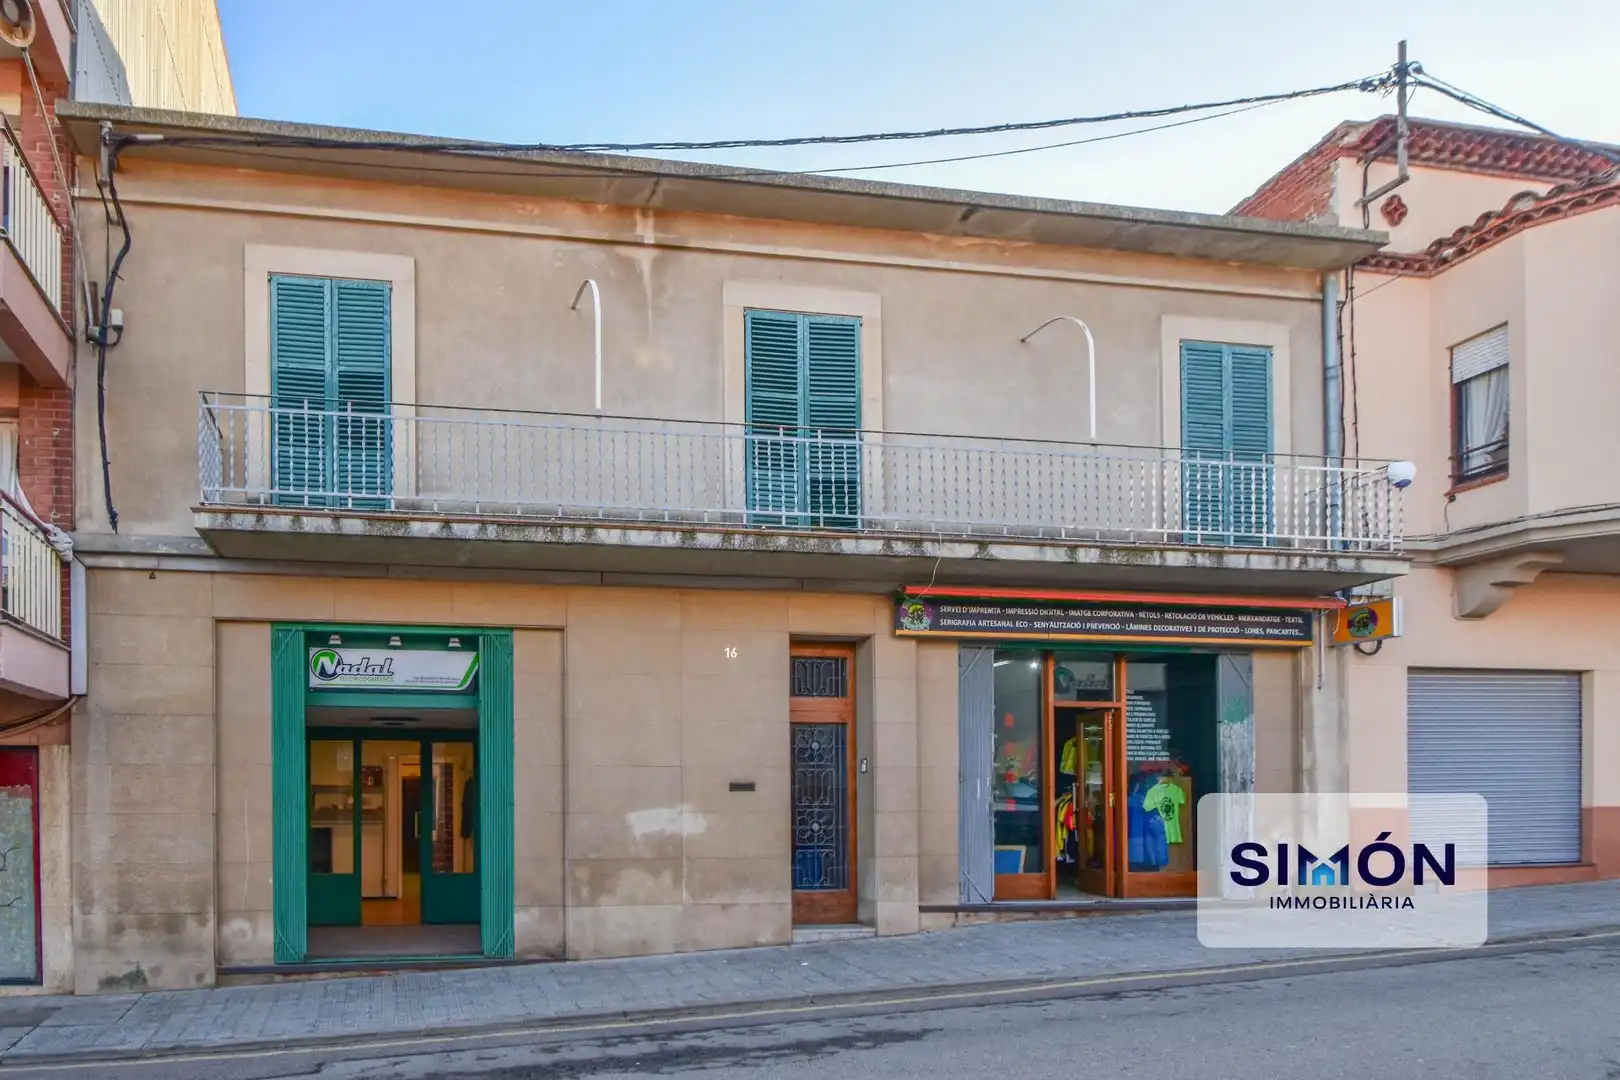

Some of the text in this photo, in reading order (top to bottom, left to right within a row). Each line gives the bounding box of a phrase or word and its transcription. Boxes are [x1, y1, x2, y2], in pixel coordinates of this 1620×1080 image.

[962, 606, 1001, 614] D'IMPREMTA
[1006, 606, 1038, 615] IMPRESSIÓ
[1039, 608, 1064, 616] DIGITAL
[1068, 609, 1092, 617] IMATGE
[1092, 610, 1135, 618] CORPORATIVA
[1164, 612, 1197, 620] RETOLACIÓ
[940, 618, 976, 626] SERIGRAFIA
[978, 619, 1014, 627] ARTESANAL
[1015, 620, 1028, 628] ECO
[1034, 620, 1080, 629] SENYALITZACIÓ
[1086, 621, 1121, 630] PREVENCIÓ
[1153, 624, 1193, 632] DECORATIVES
[1207, 625, 1240, 634] PROTECCIÓ
[724, 647, 738, 659] 16
[311, 648, 394, 681] Nadal
